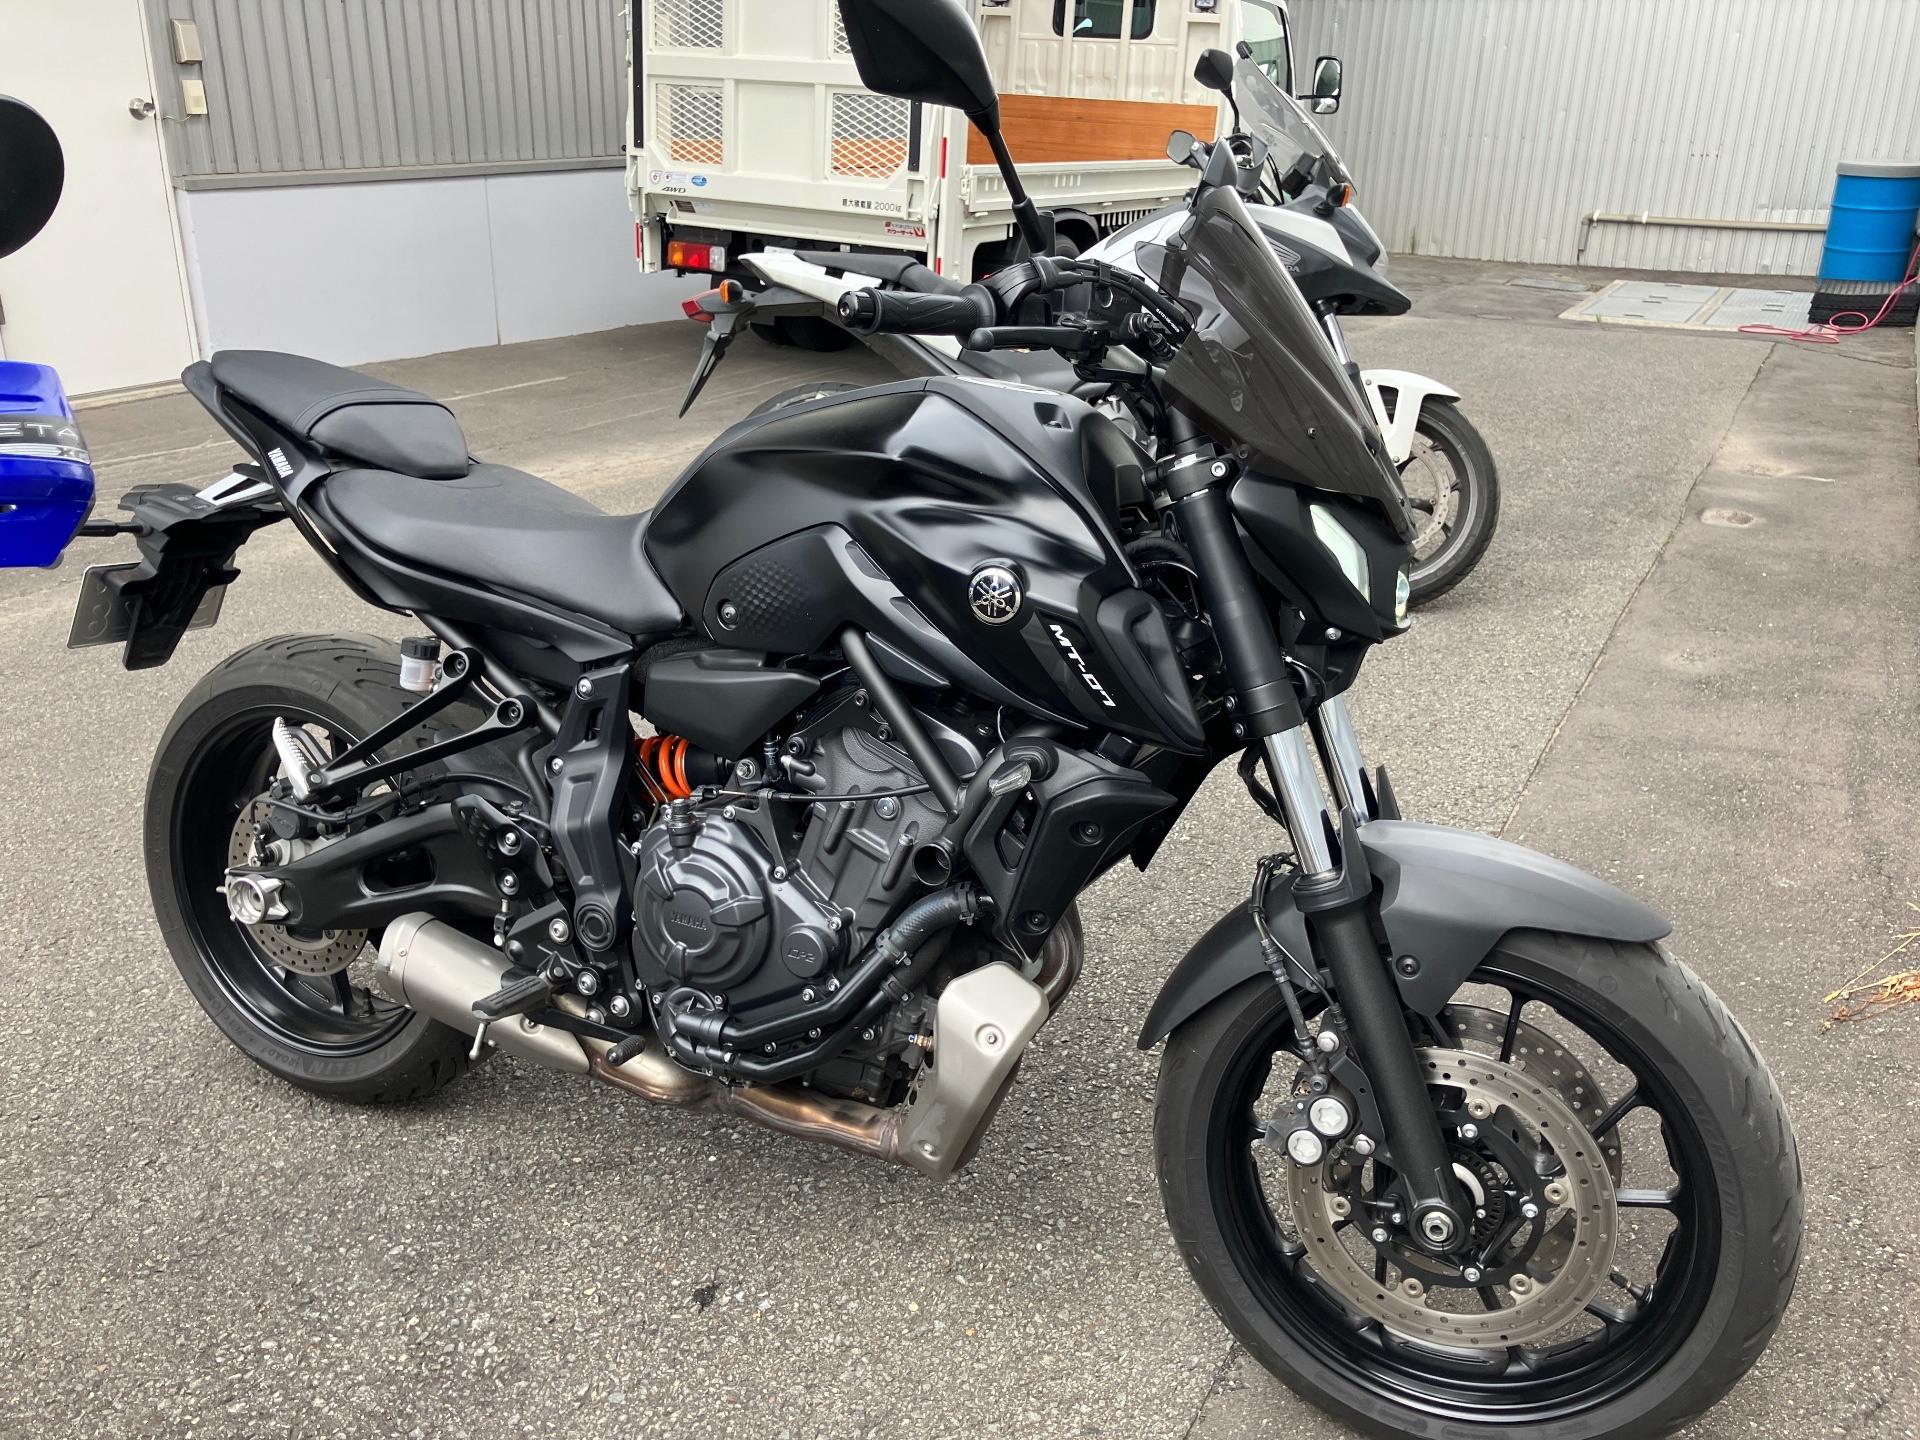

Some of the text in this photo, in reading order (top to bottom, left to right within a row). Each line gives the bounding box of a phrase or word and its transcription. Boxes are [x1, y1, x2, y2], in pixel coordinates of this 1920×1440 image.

[267, 447, 294, 479] YAMAHA
[1049, 624, 1116, 707] MT-07
[670, 909, 707, 931] YAMAHA
